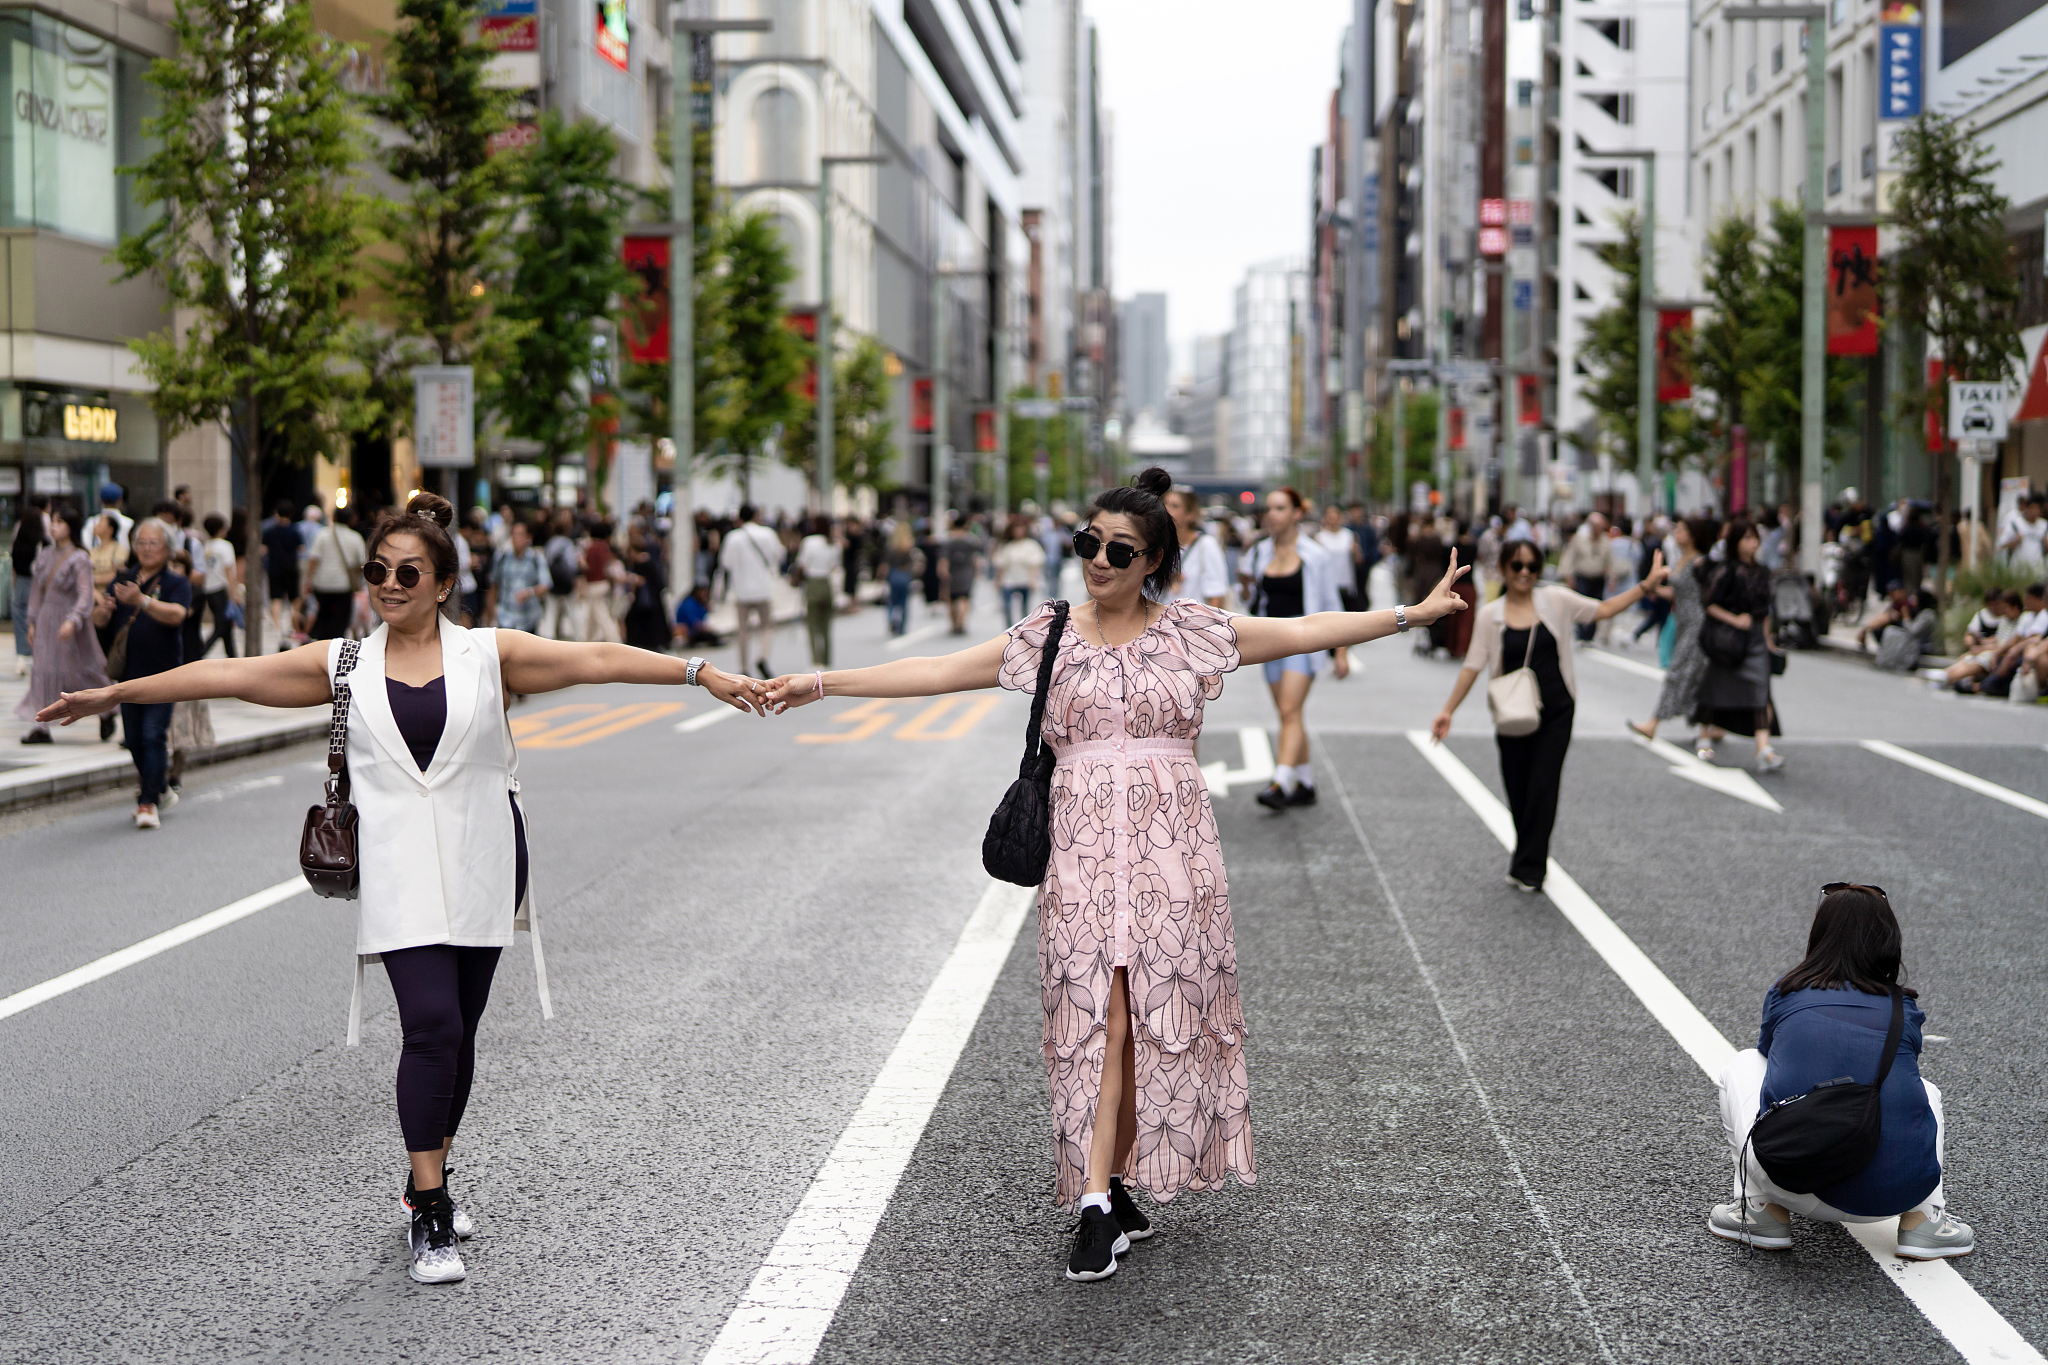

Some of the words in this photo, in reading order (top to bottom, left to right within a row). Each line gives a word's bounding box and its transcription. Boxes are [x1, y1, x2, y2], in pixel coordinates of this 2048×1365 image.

[1890, 32, 1912, 114] PLAZA
[16, 89, 67, 134] GINZA
[1958, 387, 2002, 402] TAXI
[795, 694, 1001, 744] 50
